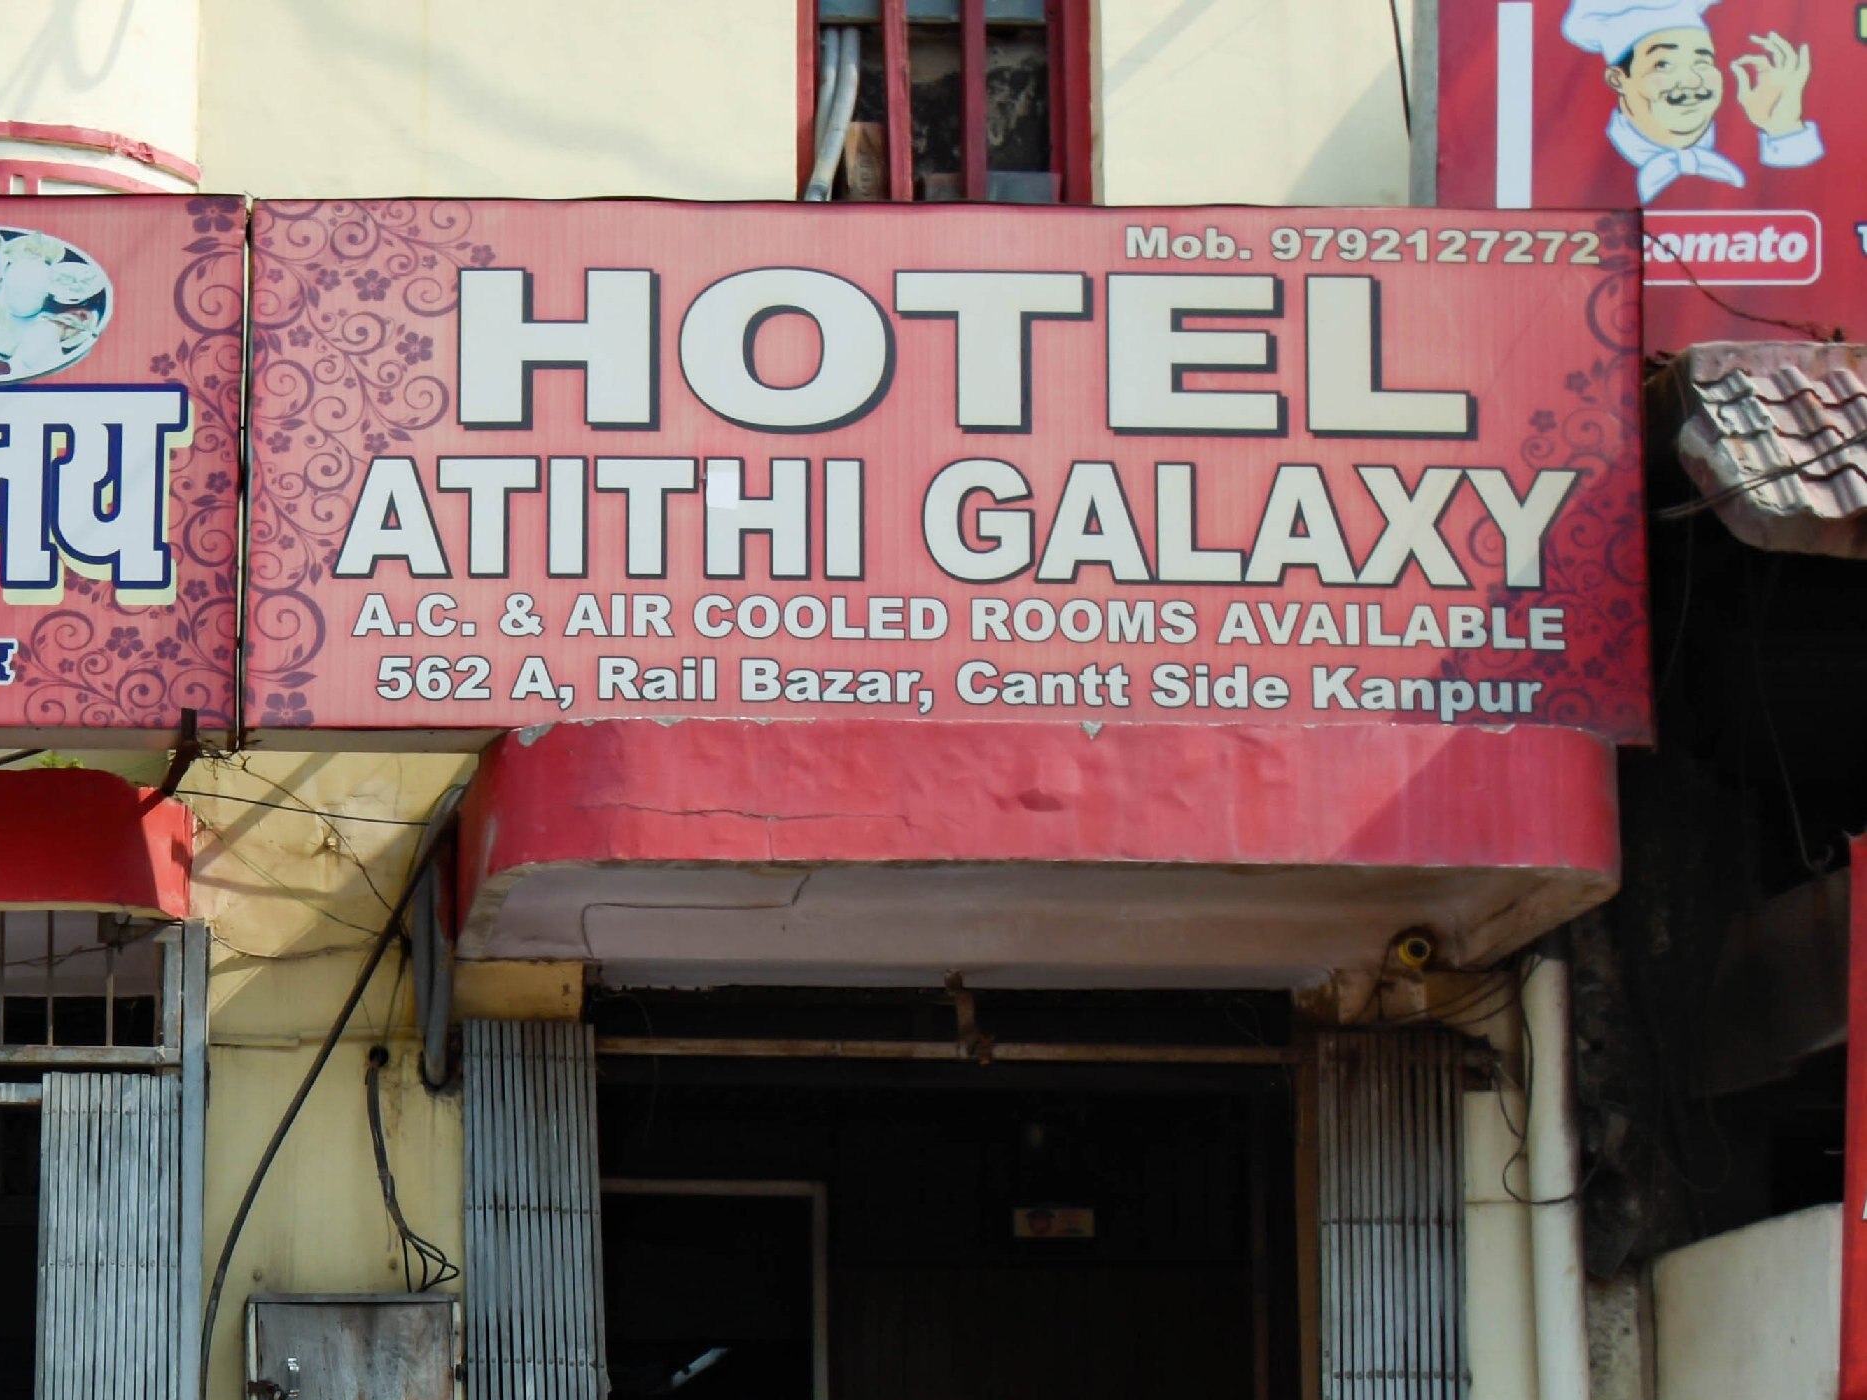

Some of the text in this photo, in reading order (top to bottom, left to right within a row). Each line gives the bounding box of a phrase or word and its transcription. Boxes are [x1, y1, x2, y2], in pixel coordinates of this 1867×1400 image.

[1125, 226, 1601, 264] Mob. 9792127272
[457, 266, 1478, 440] HOTEL
[333, 455, 1584, 590] ATITHI GALAXY
[351, 593, 1567, 651] A.C. & AIR COOLED ROOMS AVAILABLE
[376, 656, 1544, 722] 562 A, Rail Bazar, Cantt Side Kanpur
